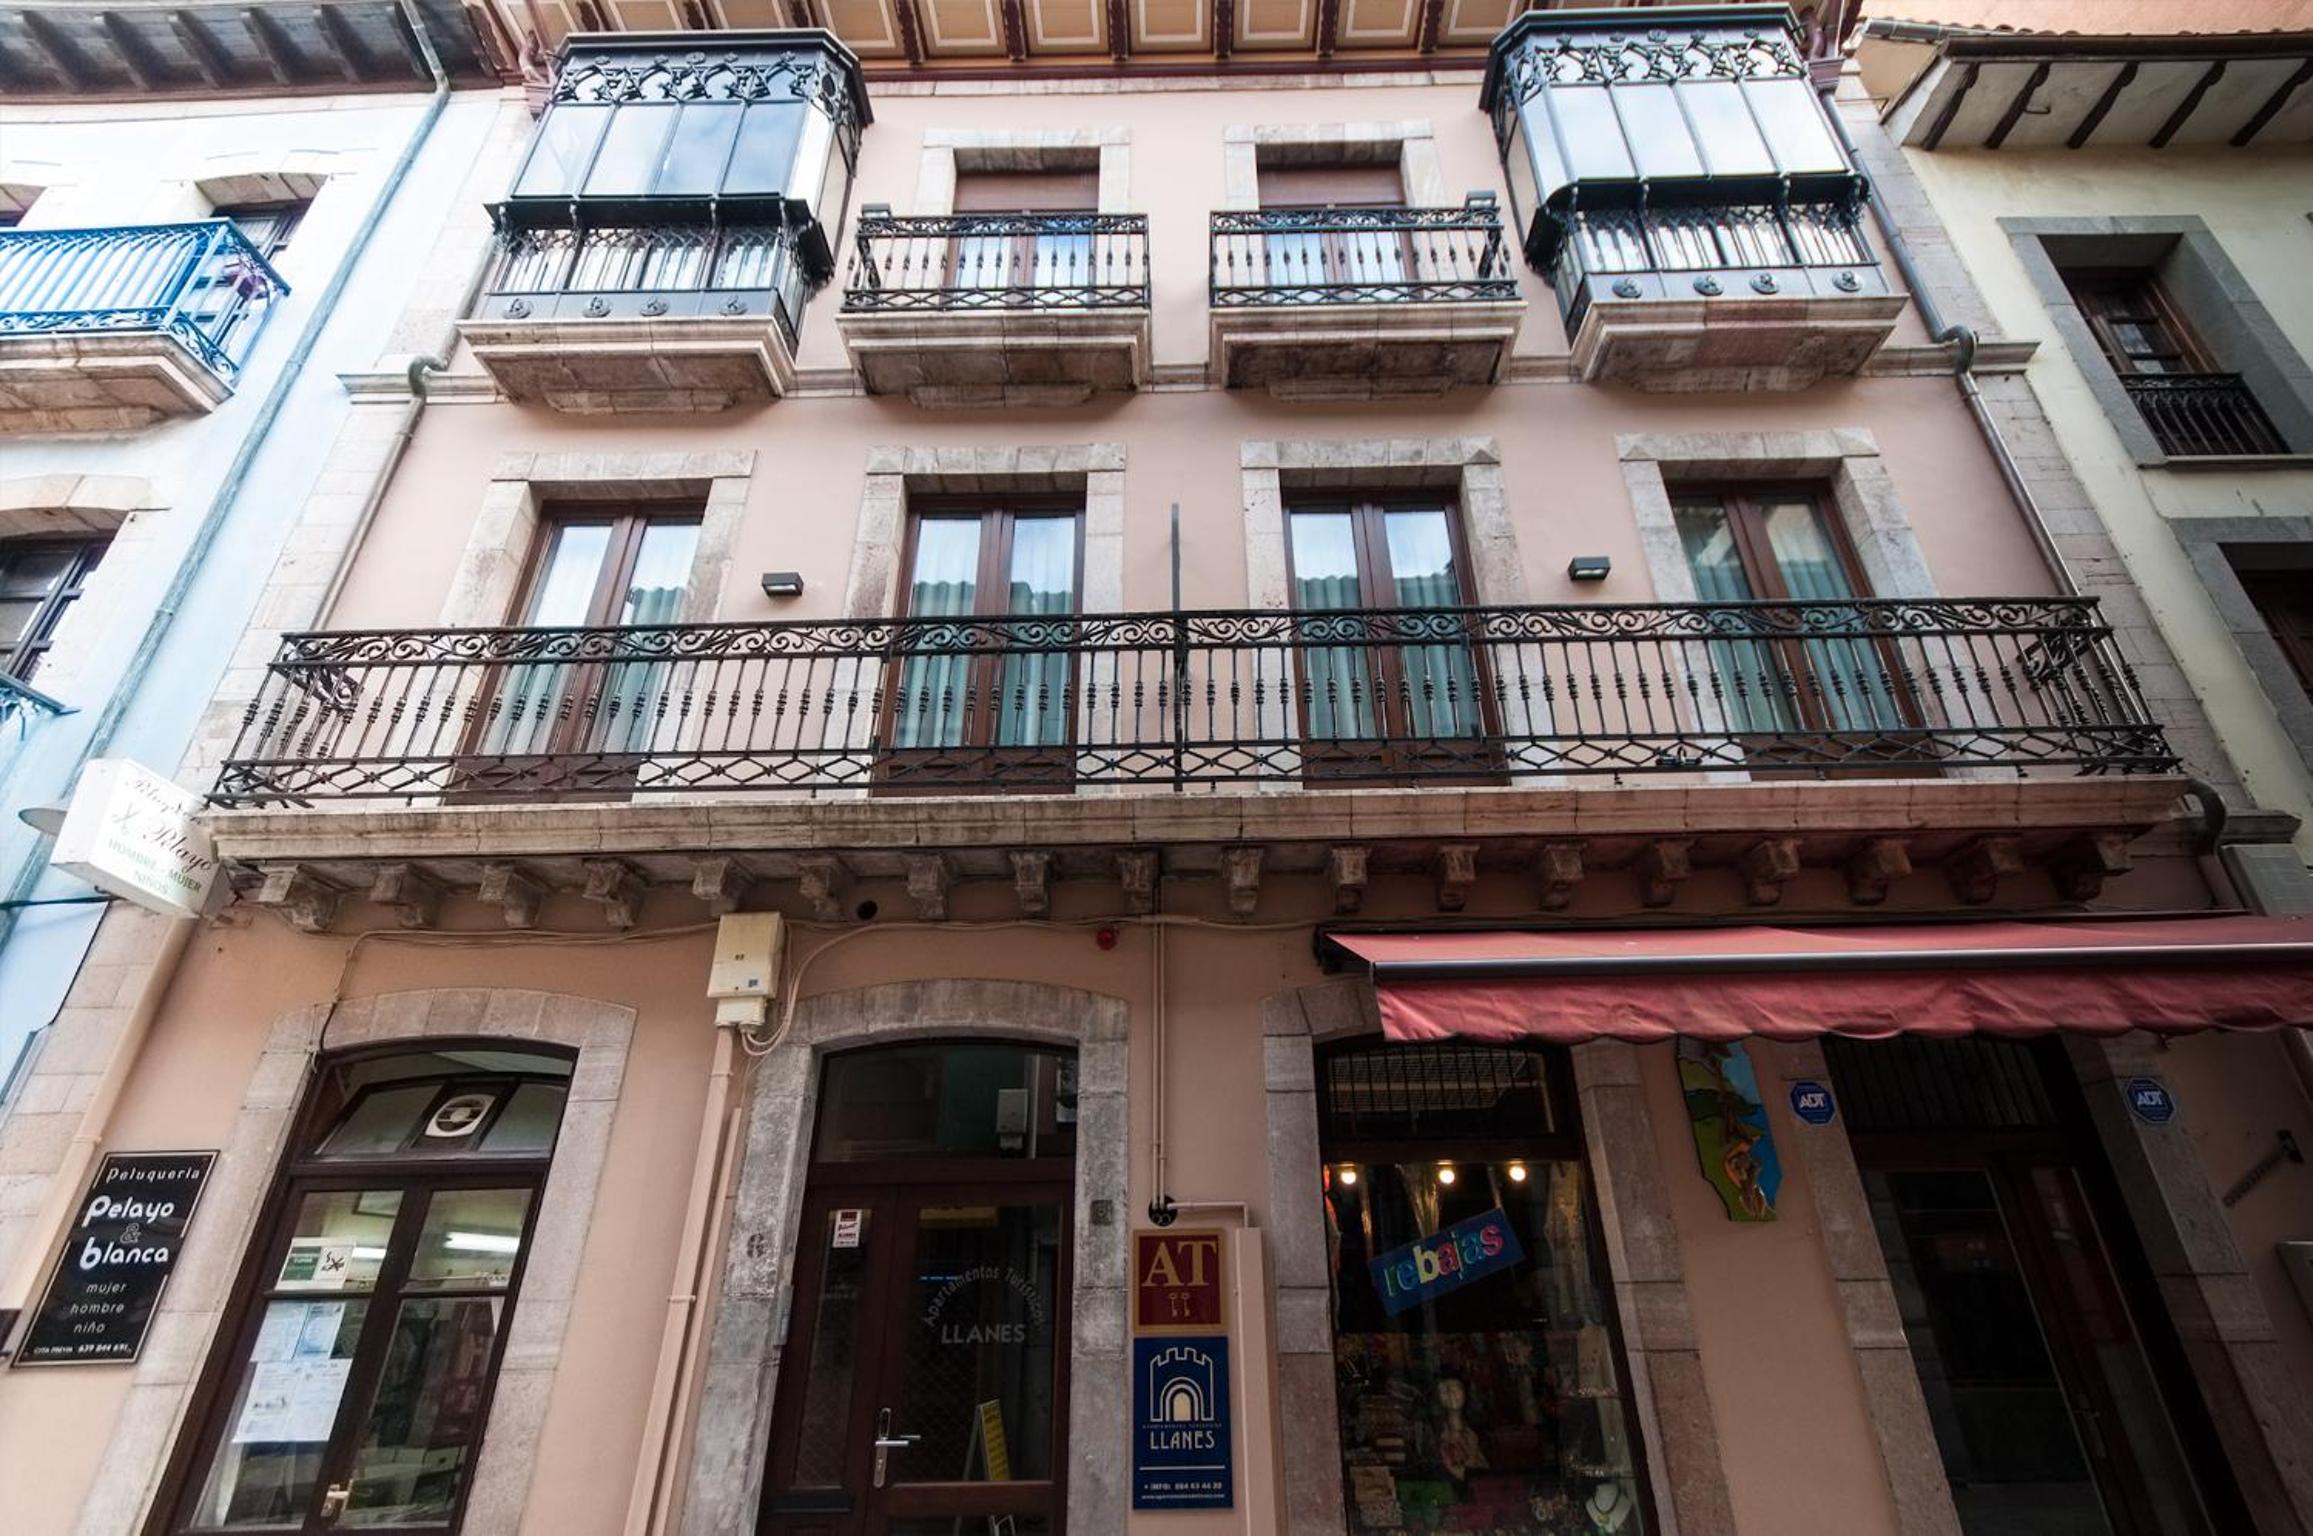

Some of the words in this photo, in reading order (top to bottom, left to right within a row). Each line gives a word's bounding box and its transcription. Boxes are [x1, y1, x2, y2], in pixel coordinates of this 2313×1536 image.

[168, 867, 203, 892] MUJER
[1799, 1093, 1826, 1109] ADT
[2136, 1090, 2163, 1106] ADT
[119, 1222, 142, 1244] &
[79, 1236, 169, 1270] blanca
[1383, 1223, 1505, 1297] rebajas
[1141, 1241, 1217, 1287] AT
[86, 1281, 127, 1294] mujer
[70, 1301, 125, 1315] hombre
[73, 1320, 106, 1334] niño
[941, 1323, 1026, 1345] LLANES
[1149, 1430, 1216, 1451] LLANES
